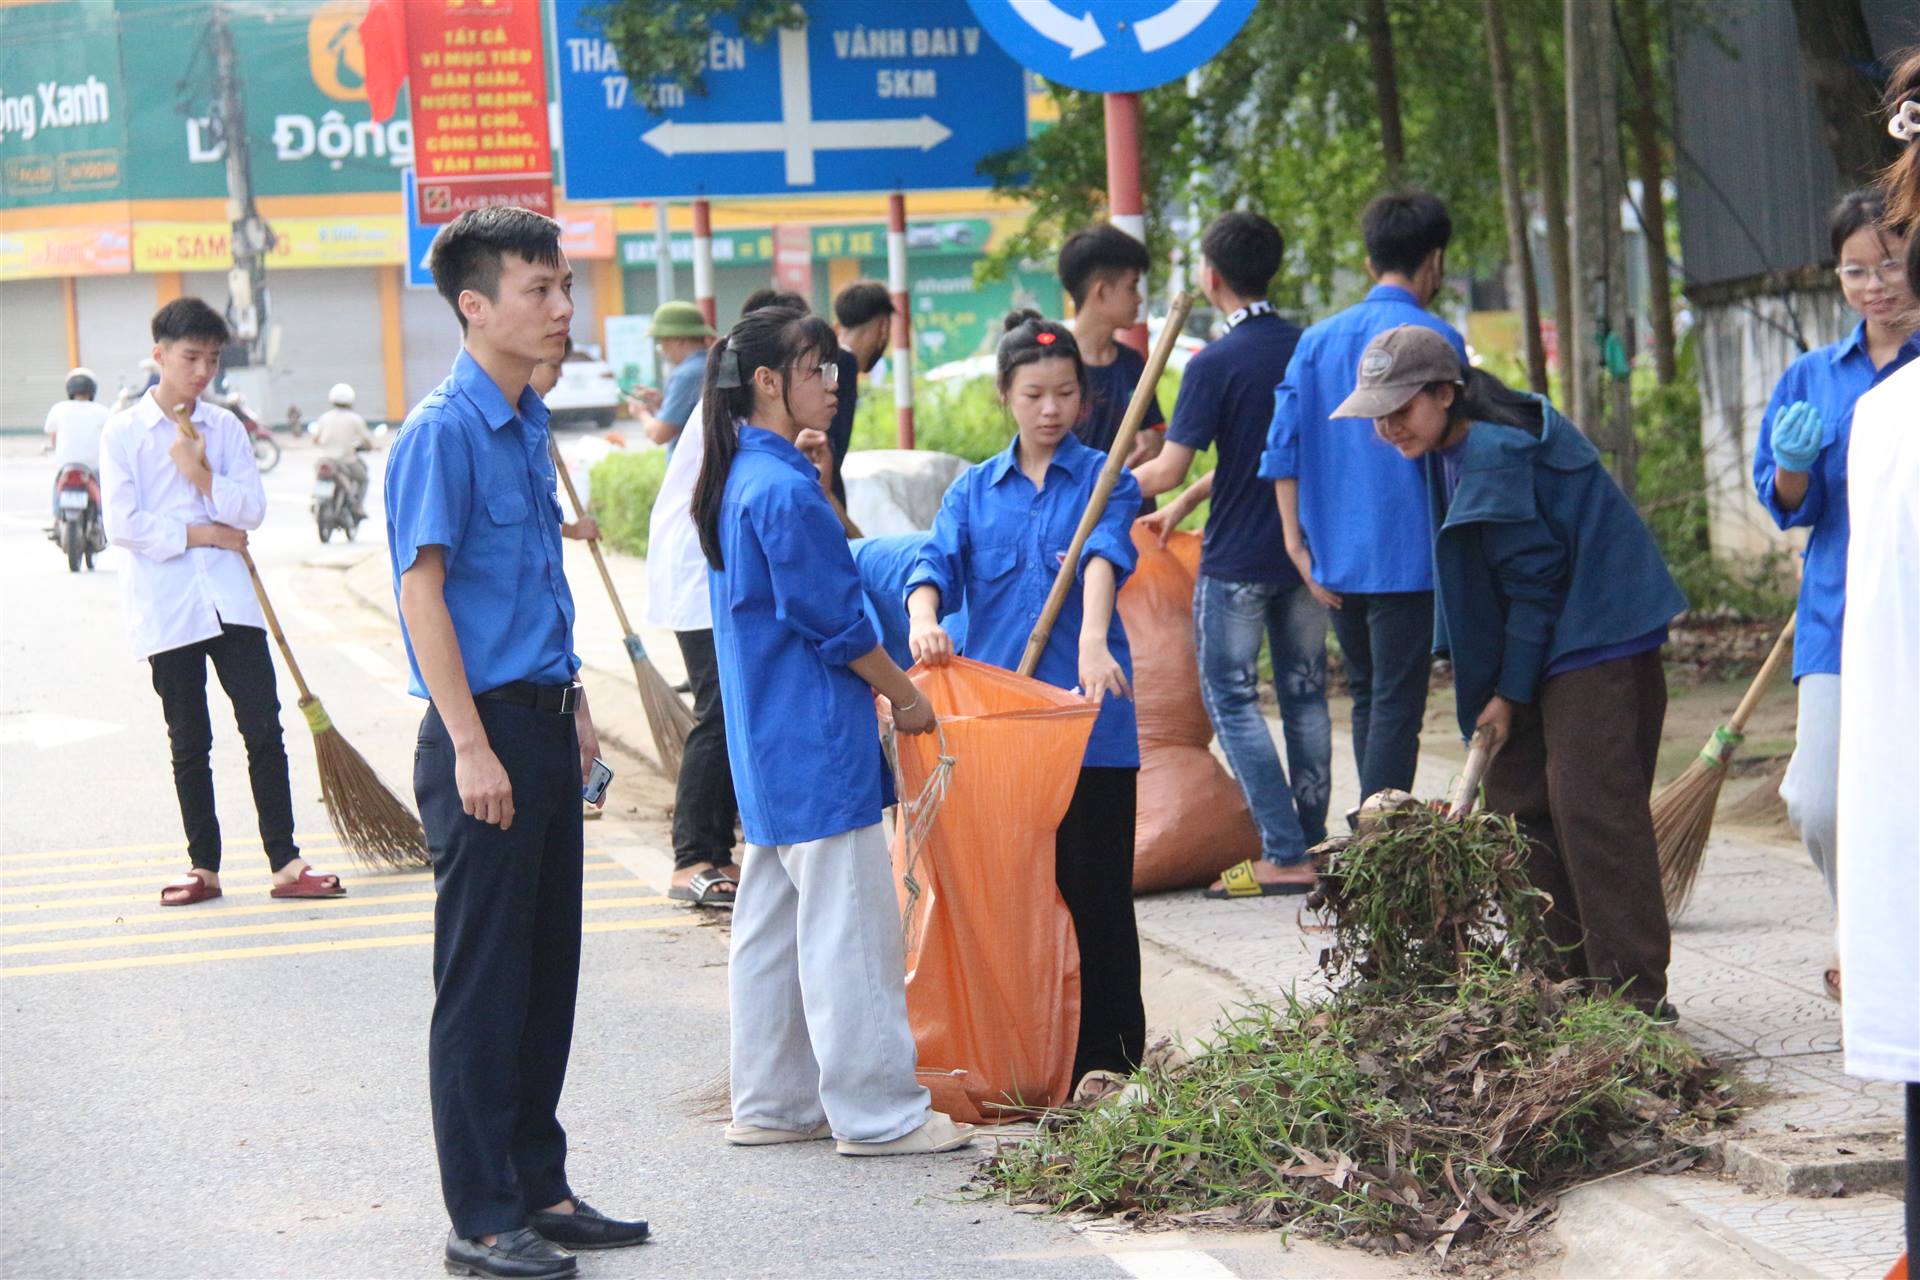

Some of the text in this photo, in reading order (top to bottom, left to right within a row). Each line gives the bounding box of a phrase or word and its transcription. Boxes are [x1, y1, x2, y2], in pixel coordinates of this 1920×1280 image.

[602, 75, 629, 109] 17
[877, 69, 937, 98] 5KM
[0, 75, 109, 141] ng Xanh
[273, 110, 415, 170] Động
[453, 192, 548, 209] AGRIBANK
